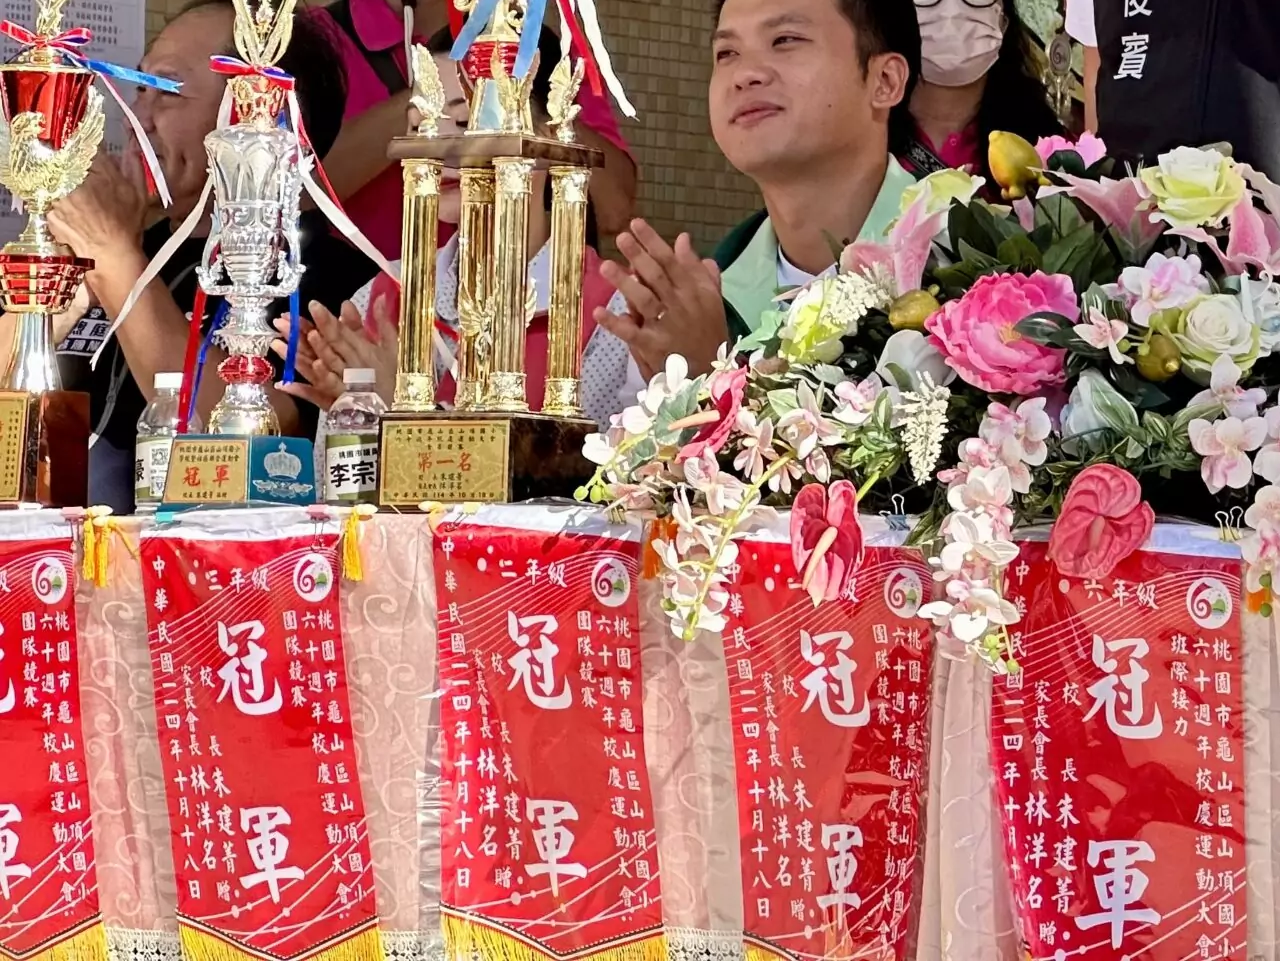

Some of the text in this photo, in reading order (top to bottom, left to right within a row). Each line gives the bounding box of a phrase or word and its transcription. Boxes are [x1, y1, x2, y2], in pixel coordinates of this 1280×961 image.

[183, 465, 230, 487] 冠軍
[205, 567, 272, 594] 三年級
[330, 460, 378, 488] 李宗
[499, 558, 568, 588] 二年級
[1083, 579, 1159, 610] 六年級
[21, 611, 39, 707] 團隊競賽
[39, 611, 76, 904] 六十週年校慶運動大會
[54, 610, 92, 902] 桃園市龜山區山頂國小
[152, 556, 201, 900] 中華民國一一四年十月十八日
[216, 619, 306, 904] 冠軍
[283, 610, 307, 708] 團隊競賽
[300, 610, 353, 905] 六十週年校慶運動大會
[317, 609, 367, 903] 桃園市龜山區山頂國小
[441, 537, 475, 889] 中華民國一一四年十月十八日
[506, 609, 588, 899] 冠軍
[577, 609, 599, 709] 團隊競賽
[596, 614, 637, 911] 六十週年校慶運動大會
[614, 614, 653, 909] 桃園市龜山區山頂國小
[800, 628, 871, 931] 冠軍
[872, 623, 892, 726] 團隊競賽
[1075, 634, 1163, 950] 冠軍
[1170, 633, 1190, 737] 班際接力
[1194, 638, 1216, 959] 六十週年校慶運動大會
[1214, 638, 1236, 959] 桃園市龜山區山頂國小
